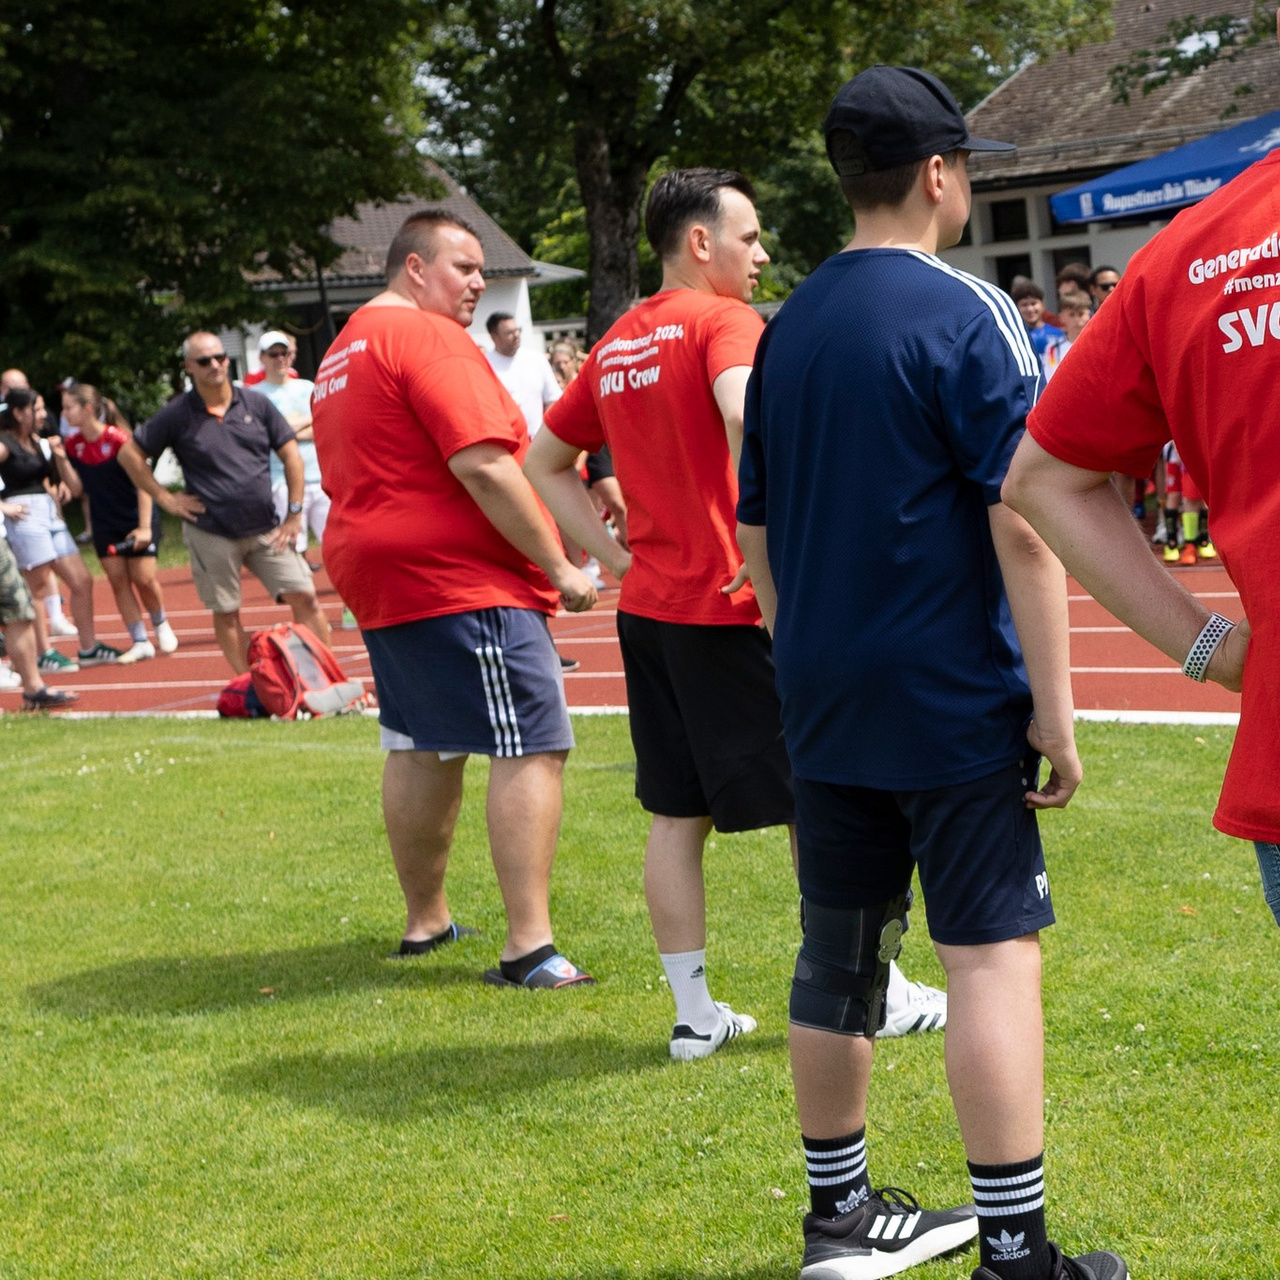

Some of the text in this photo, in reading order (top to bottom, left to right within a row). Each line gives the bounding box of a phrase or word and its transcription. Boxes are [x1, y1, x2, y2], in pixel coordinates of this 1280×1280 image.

[653, 324, 684, 341] 2024
[627, 365, 661, 389] Crew
[991, 1247, 1031, 1261] adidas
